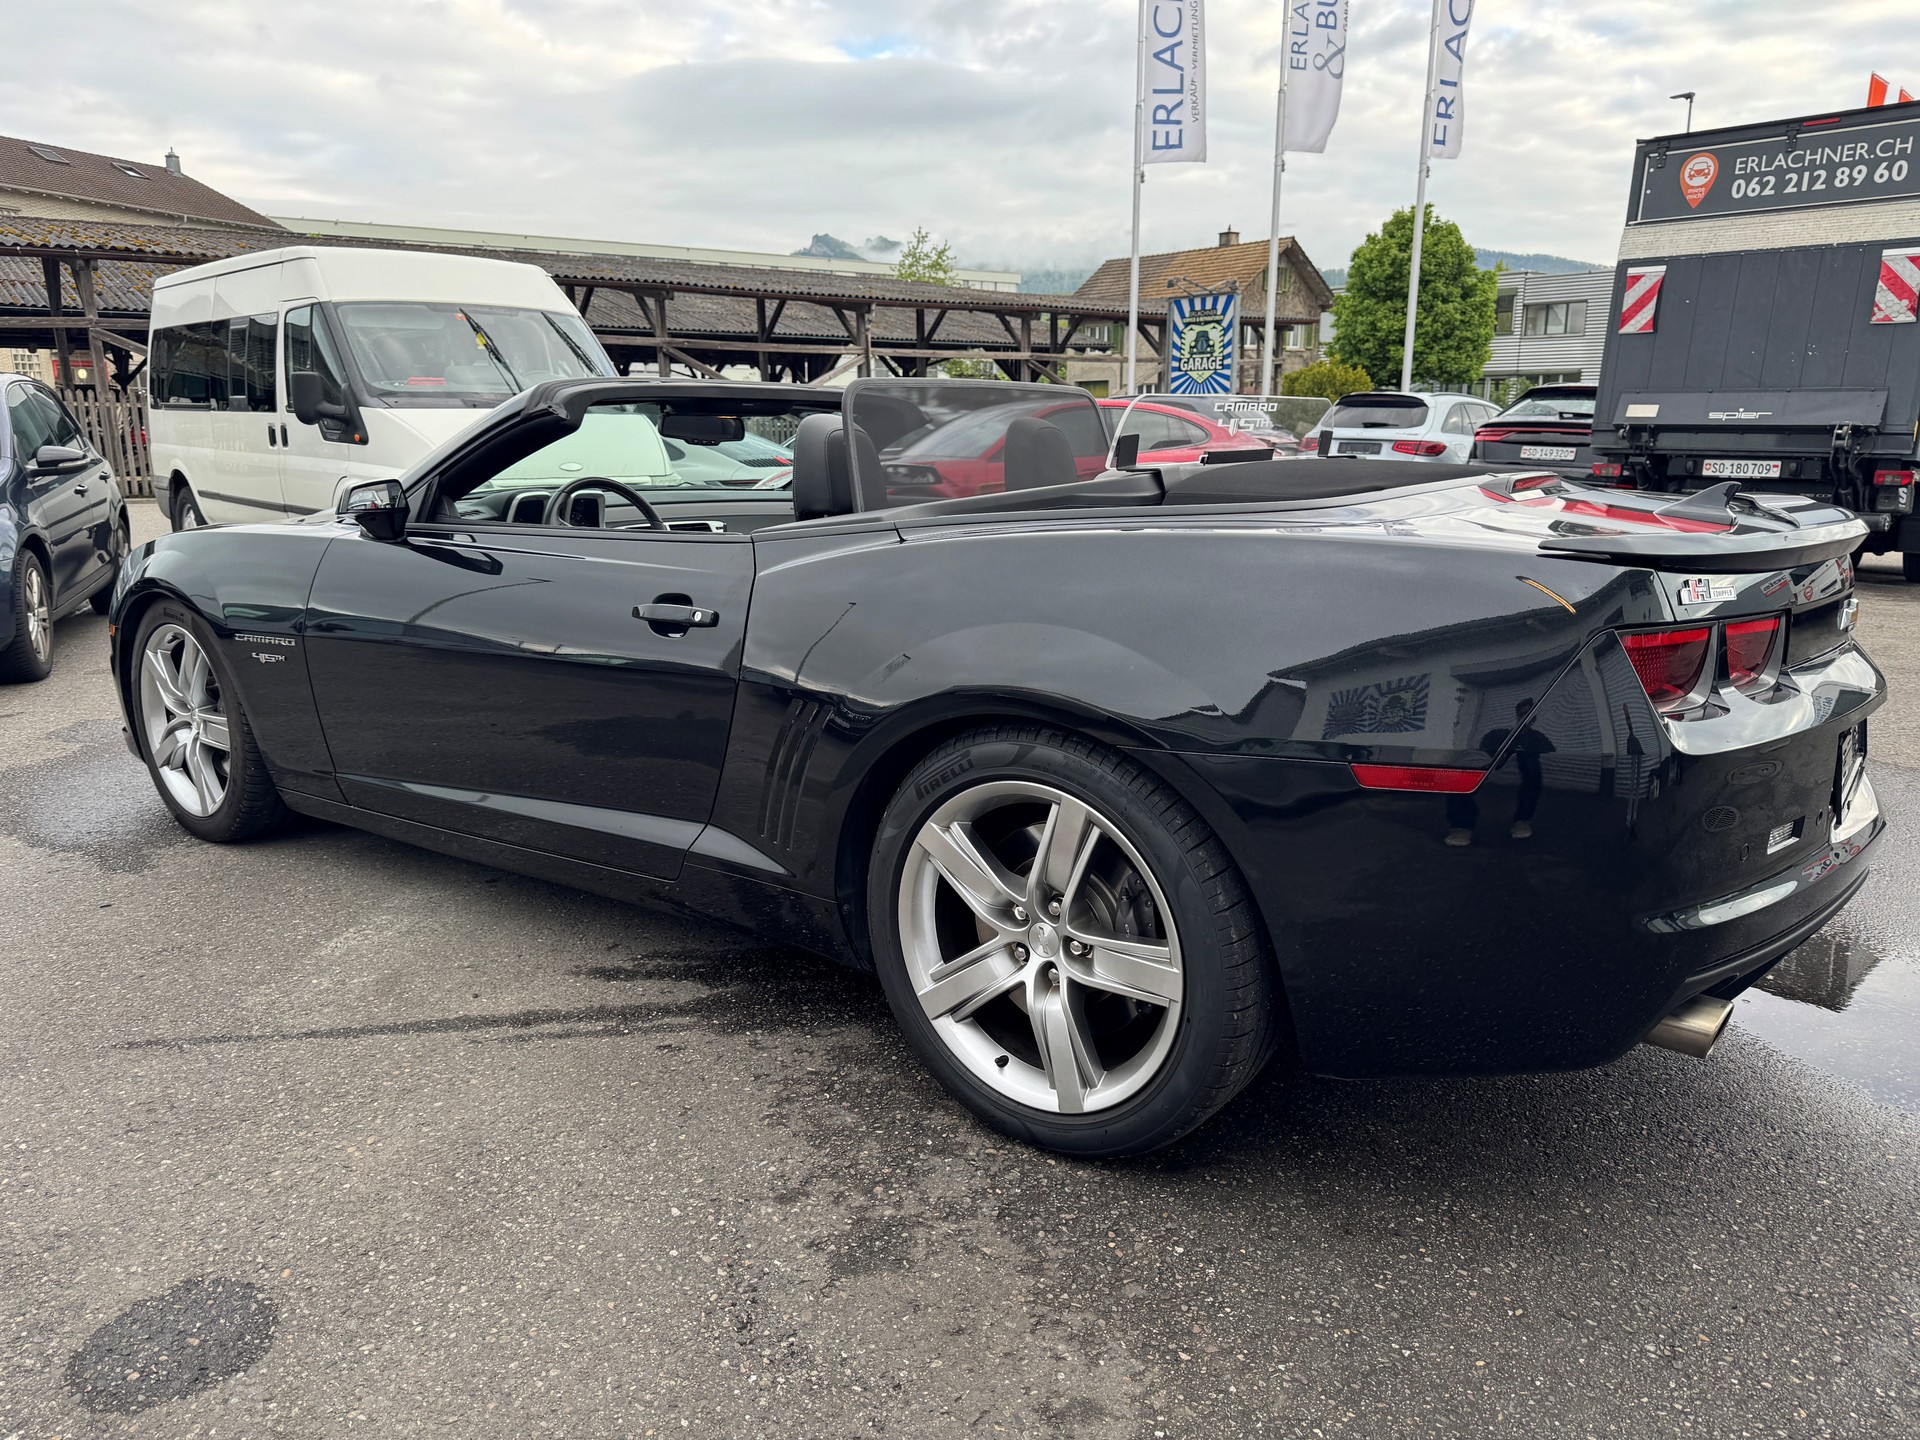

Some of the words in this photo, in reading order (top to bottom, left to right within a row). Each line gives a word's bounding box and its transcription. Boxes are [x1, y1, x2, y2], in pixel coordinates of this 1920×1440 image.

[1152, 0, 1184, 150] ERLAC
[1734, 136, 1914, 175] ERLACHNER.CH
[1731, 177, 1776, 199] 062
[1783, 169, 1828, 194] 212
[1833, 164, 1868, 188] 89
[1873, 159, 1908, 185] 60
[1180, 356, 1223, 371] GARAGE
[1213, 402, 1278, 412] CAMARO
[1708, 408, 1773, 421] spier
[234, 633, 296, 646] CAMARO
[914, 749, 975, 801] PIRELLI
